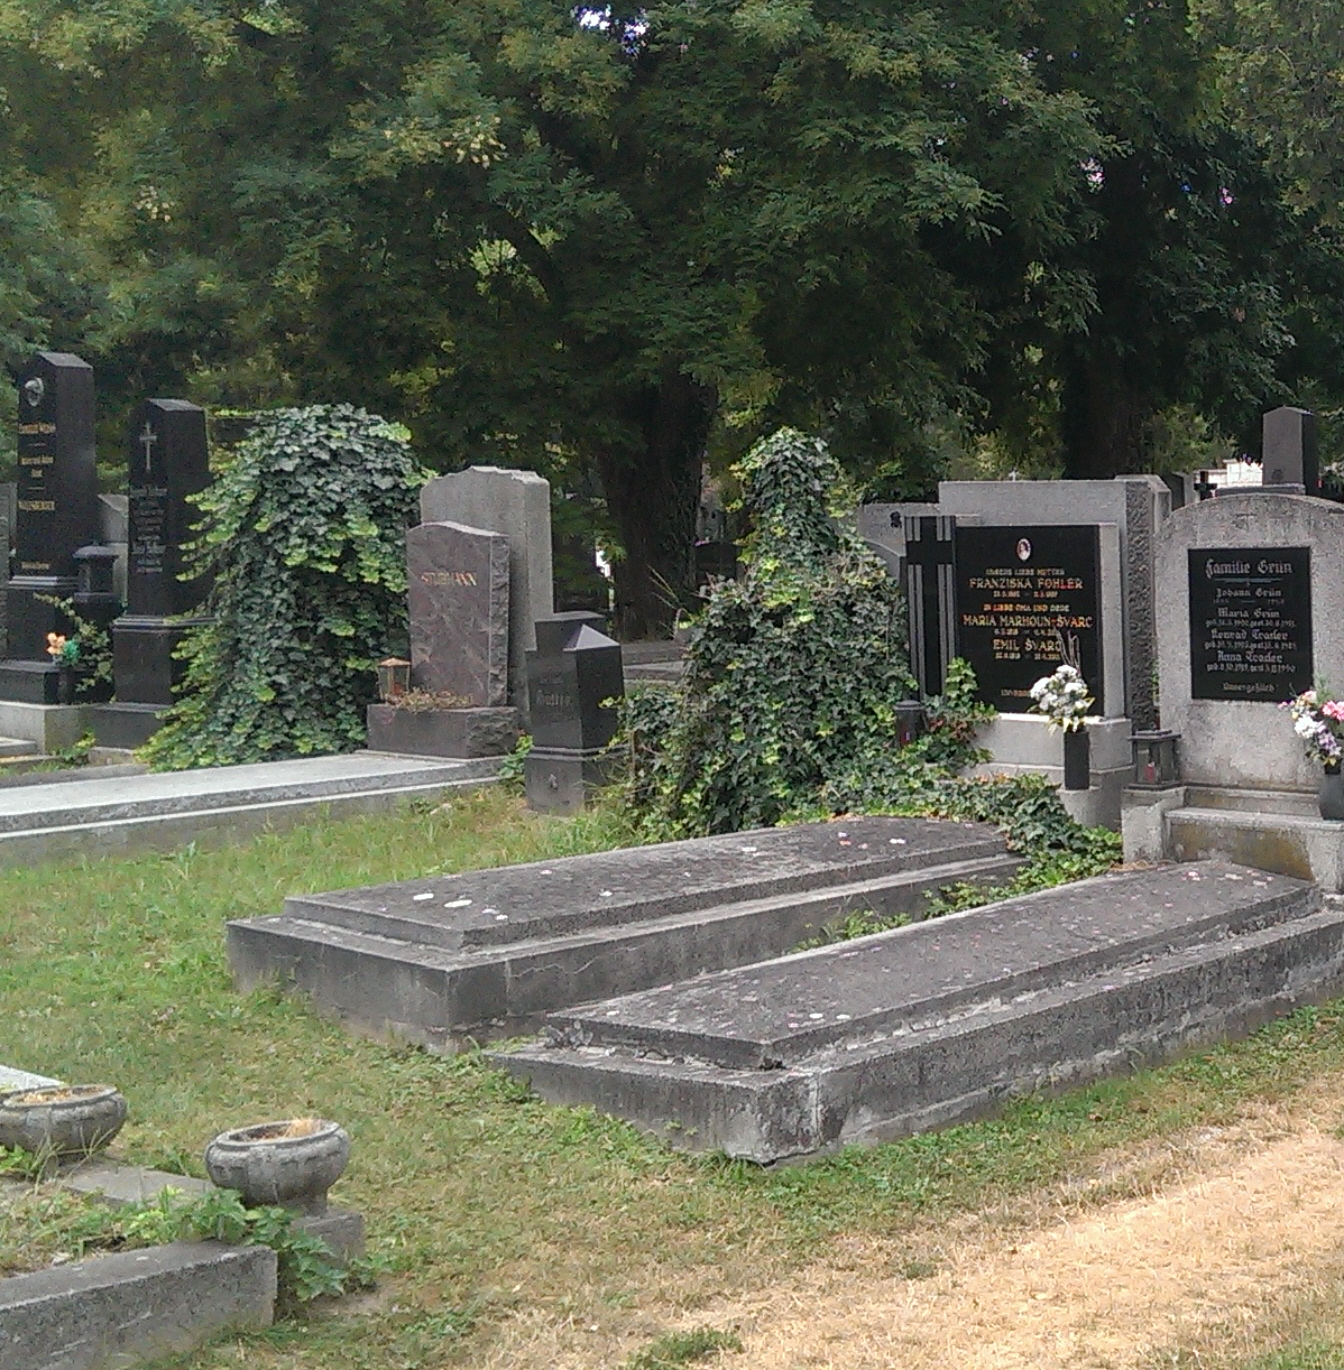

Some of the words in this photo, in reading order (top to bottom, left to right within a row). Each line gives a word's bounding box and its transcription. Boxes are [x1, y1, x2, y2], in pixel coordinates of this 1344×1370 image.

[1205, 558, 1251, 579] Familie
[1257, 559, 1294, 574] Grün
[969, 578, 1033, 590] FRANZISKA
[1037, 578, 1084, 590] FOHLER
[963, 614, 997, 627] MARIA
[993, 639, 1021, 651] EMIL
